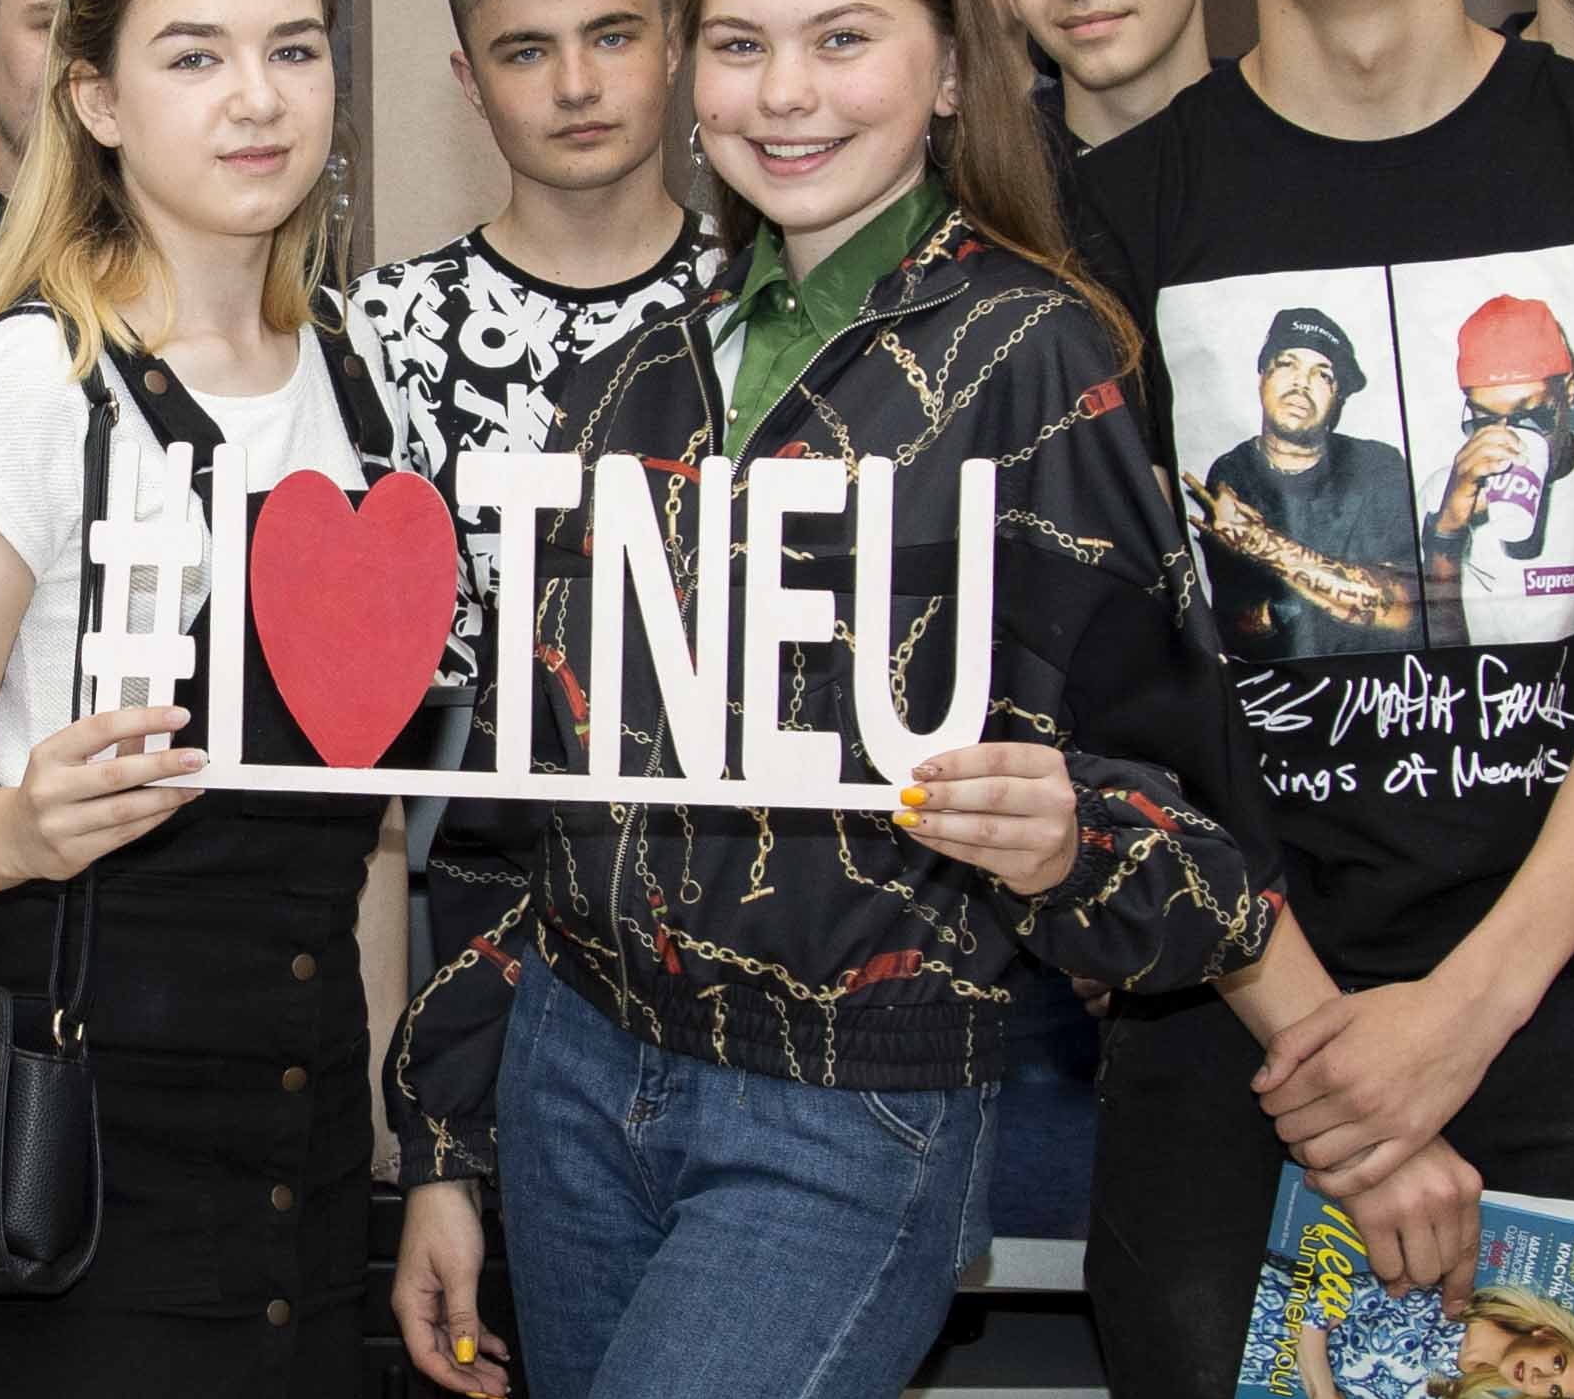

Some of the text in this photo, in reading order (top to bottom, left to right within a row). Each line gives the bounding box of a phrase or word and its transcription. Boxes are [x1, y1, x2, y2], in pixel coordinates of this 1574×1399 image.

[456, 451, 996, 785] TNEU
[1384, 752, 1437, 798] of
[1284, 1224, 1323, 1341] summer
[1547, 1242, 1572, 1298] КРАСУНЬ
[1268, 1337, 1304, 1398] you!
